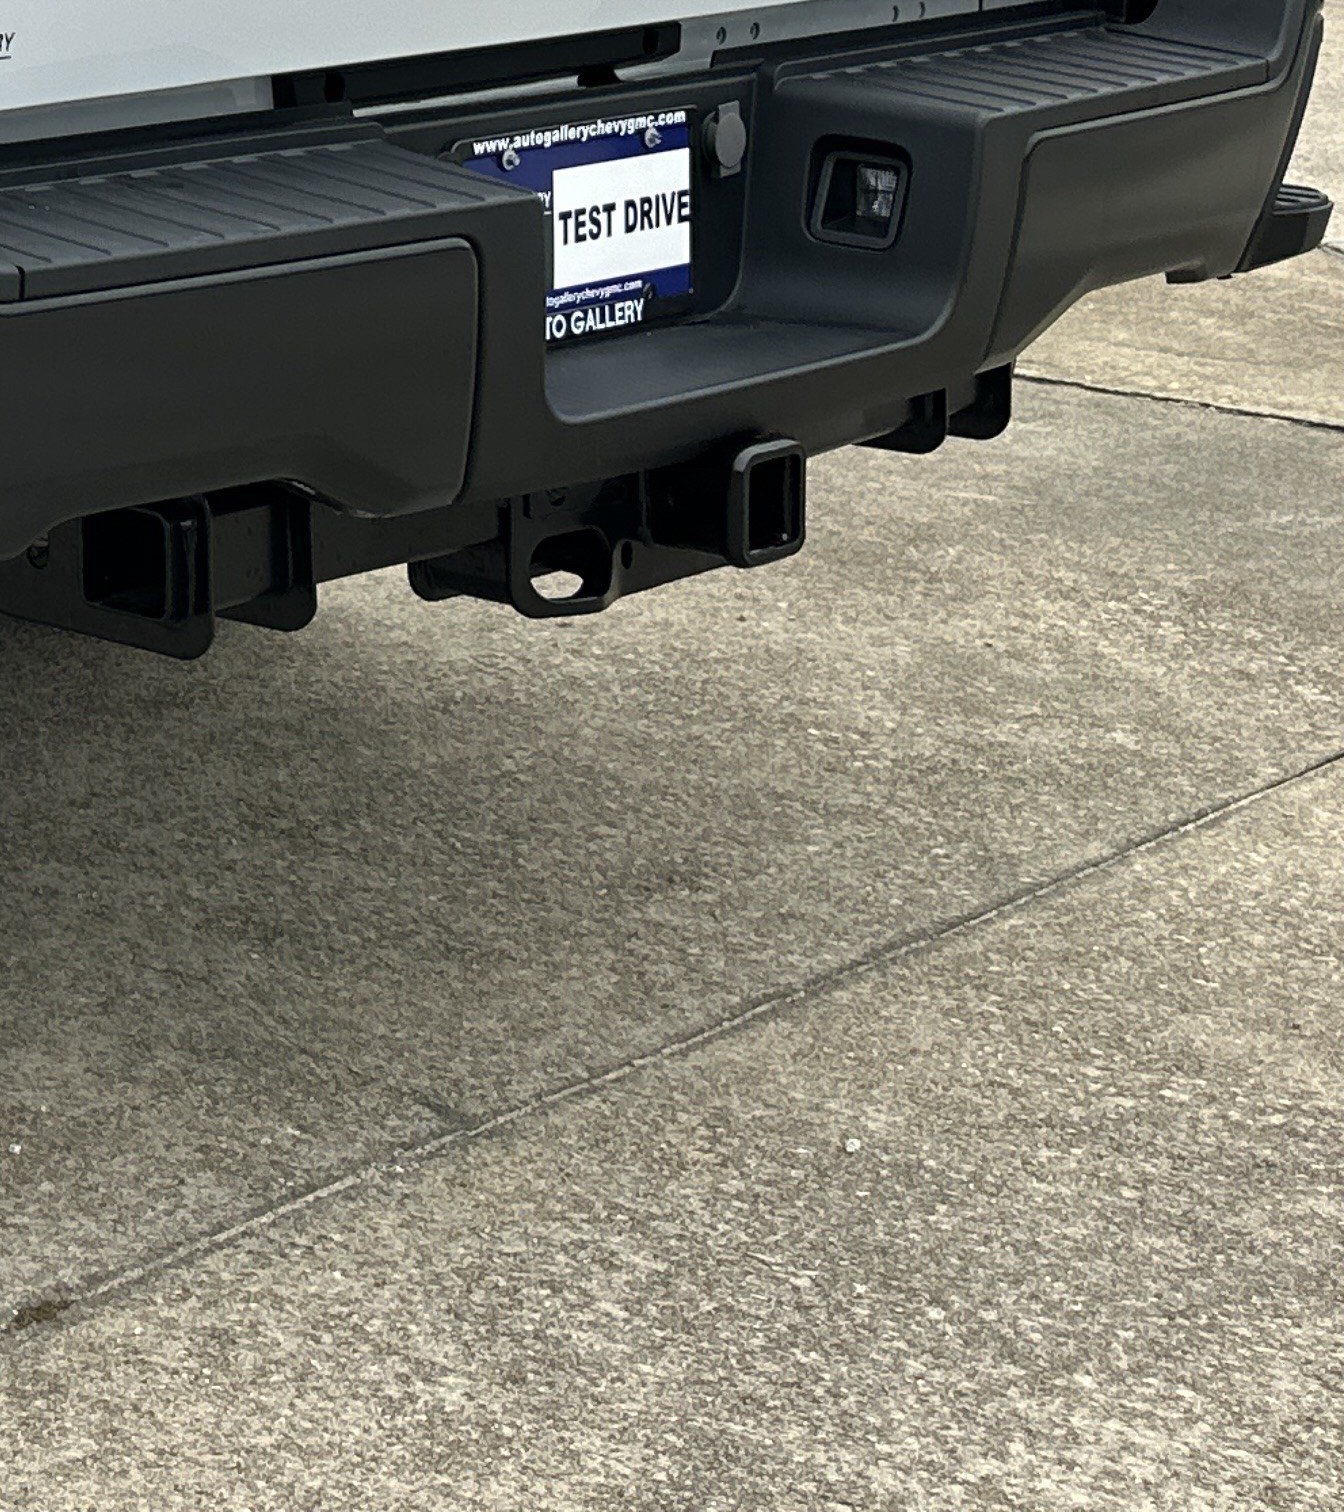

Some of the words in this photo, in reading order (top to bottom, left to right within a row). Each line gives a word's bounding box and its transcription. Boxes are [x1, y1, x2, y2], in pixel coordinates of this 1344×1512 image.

[473, 110, 687, 155] www.autogallerychevygmc.com
[558, 201, 617, 246] TEST
[624, 189, 691, 233] DRIVE
[570, 297, 645, 335] GALLERY
